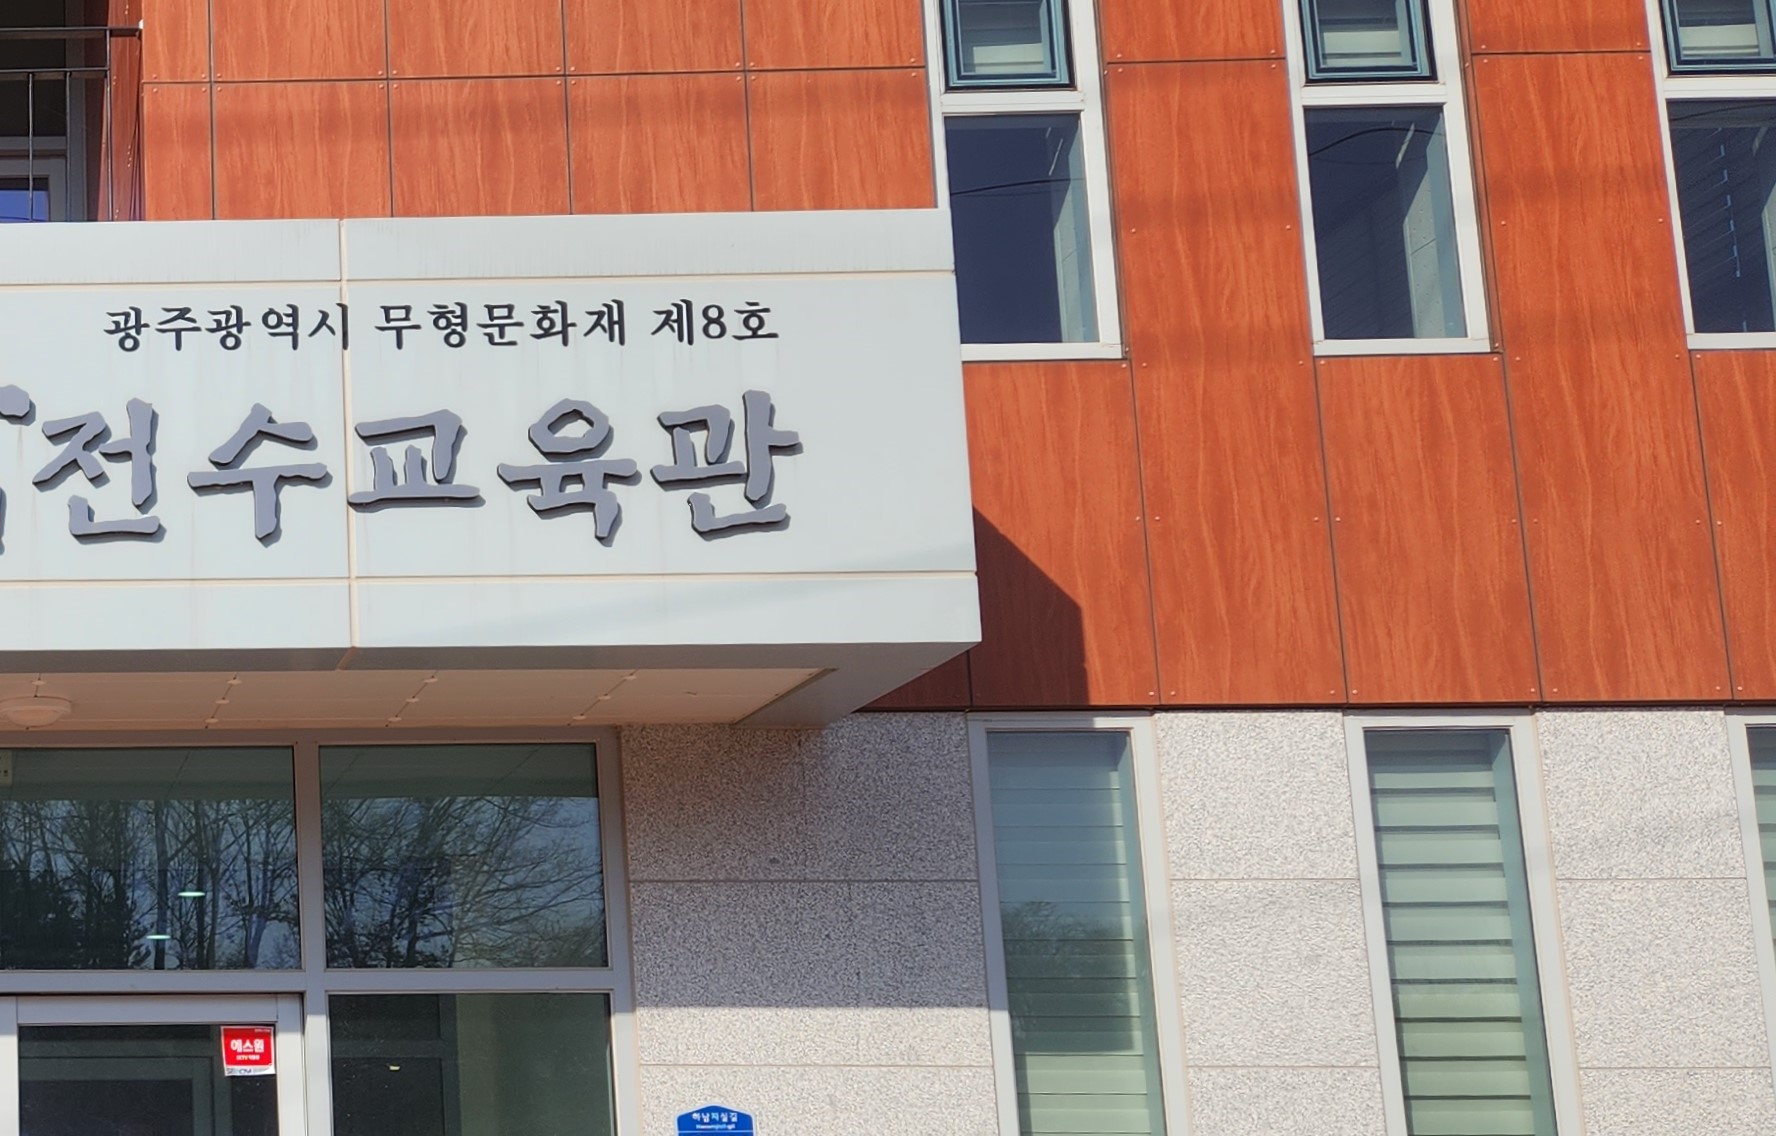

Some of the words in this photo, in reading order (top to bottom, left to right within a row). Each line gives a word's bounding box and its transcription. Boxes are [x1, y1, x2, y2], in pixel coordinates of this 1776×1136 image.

[103, 303, 352, 353] 광주광역시
[374, 299, 627, 348] 무형문화재
[650, 299, 780, 347] 제8호
[230, 1038, 265, 1053] 에스원
